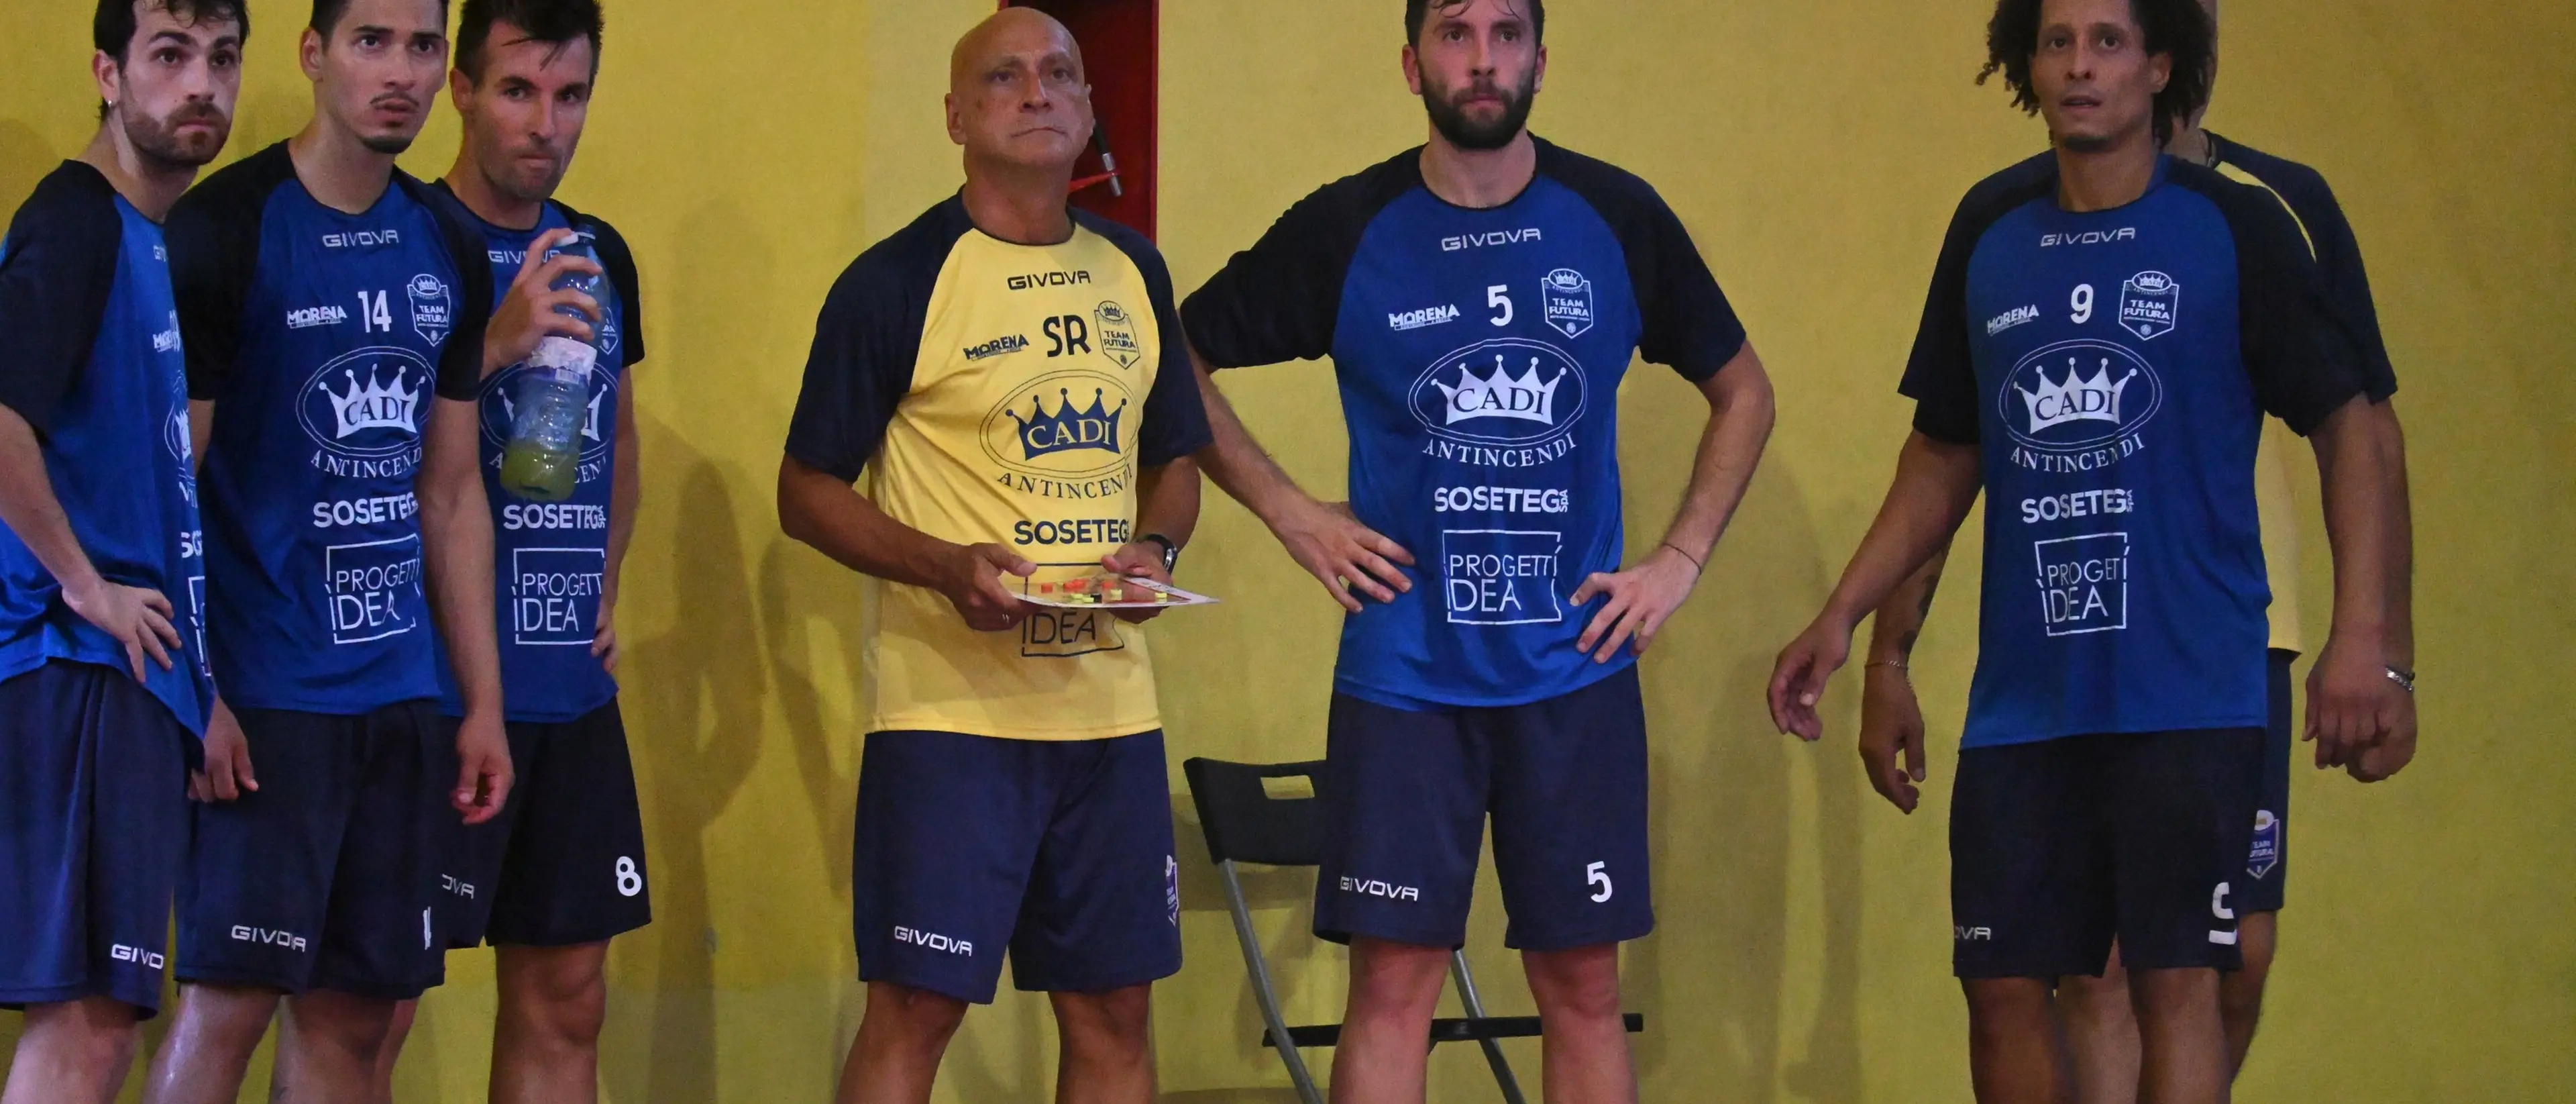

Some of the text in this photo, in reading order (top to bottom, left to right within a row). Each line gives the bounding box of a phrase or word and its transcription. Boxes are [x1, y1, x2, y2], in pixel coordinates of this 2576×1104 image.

[323, 230, 398, 248] GIVOVA
[1441, 228, 1541, 251] GIVOVA
[2040, 227, 2135, 248] GIVOVA
[1007, 270, 1091, 290] GIVOVA
[287, 305, 347, 325] MORENA
[358, 290, 392, 333] 14
[419, 305, 444, 313] TEAM
[1388, 303, 1460, 328] MORENA
[1487, 285, 1513, 326] 5
[1549, 306, 1589, 317] FUTURA
[1552, 298, 1584, 308] TEAM
[2070, 283, 2094, 324] 9
[2124, 307, 2170, 320] FUTURA
[2130, 299, 2165, 311] TEAM
[416, 313, 448, 323] FUTURA
[1987, 303, 2039, 334] MORENA
[963, 334, 1030, 360] MORENA
[1042, 315, 1092, 358] SR
[1103, 338, 1136, 349] FUTURA
[1104, 330, 1130, 340] TEAM
[343, 396, 409, 424] CADI
[1452, 386, 1546, 415] CADI
[2035, 389, 2116, 423] CADI
[1027, 418, 1111, 449] CADI
[311, 447, 422, 479] ANTINCEND
[1422, 432, 1578, 468] ANTINCENDI
[1434, 485, 1560, 513] SOSETEG
[2021, 489, 2127, 523] SOSETEG
[503, 504, 598, 530] SOSETEG
[523, 573, 602, 596] PROGETT
[615, 856, 642, 897] 8
[1340, 876, 1419, 901] GIVOVA
[1586, 860, 1613, 903] 5
[894, 925, 972, 956] GIVOVA
[111, 944, 164, 970] GIVO
